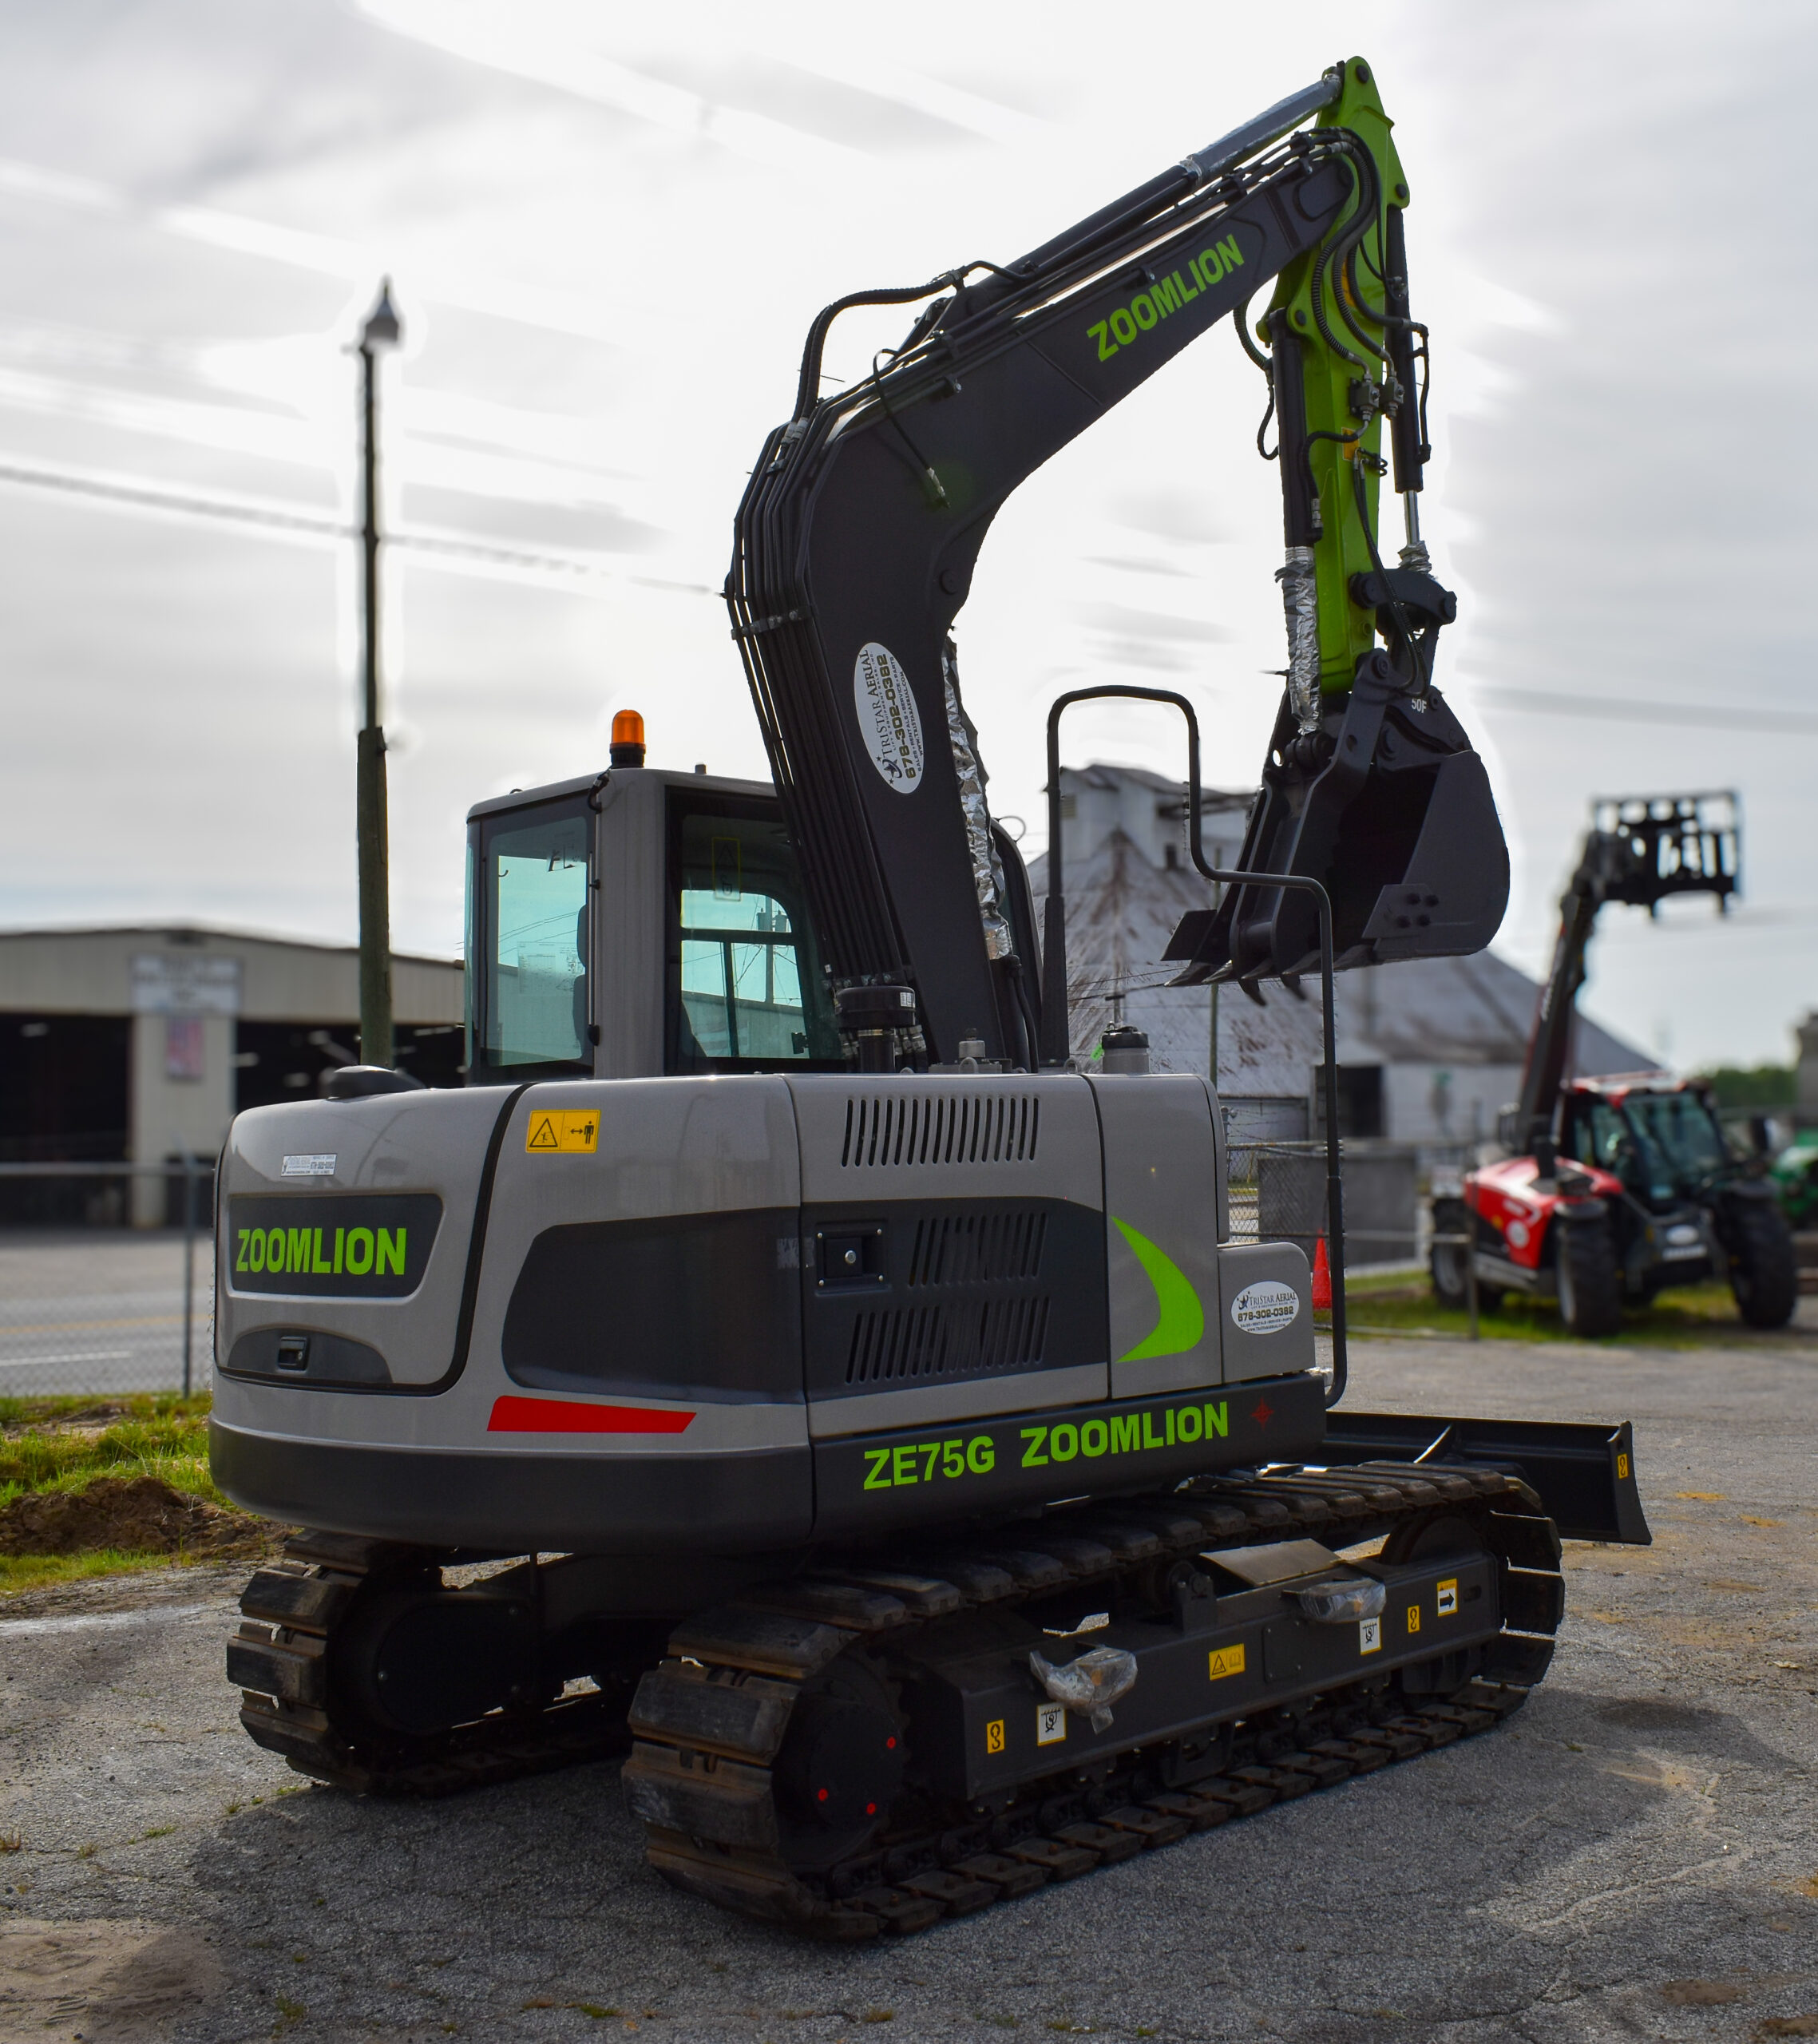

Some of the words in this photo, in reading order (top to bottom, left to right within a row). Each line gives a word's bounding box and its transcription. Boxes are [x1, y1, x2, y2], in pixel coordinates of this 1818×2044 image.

[1087, 235, 1244, 362] ZOOMLION
[859, 650, 879, 696] AERIAL
[896, 683, 906, 711] SERVICE
[876, 654, 917, 778] 678-302-0382
[904, 715, 916, 747] RENTALS
[236, 1226, 407, 1276] ZOOMLION
[1238, 1305, 1294, 1322] 678-302-0382
[863, 1436, 995, 1491] ZE75G
[1020, 1400, 1229, 1468] ZOOMLION
